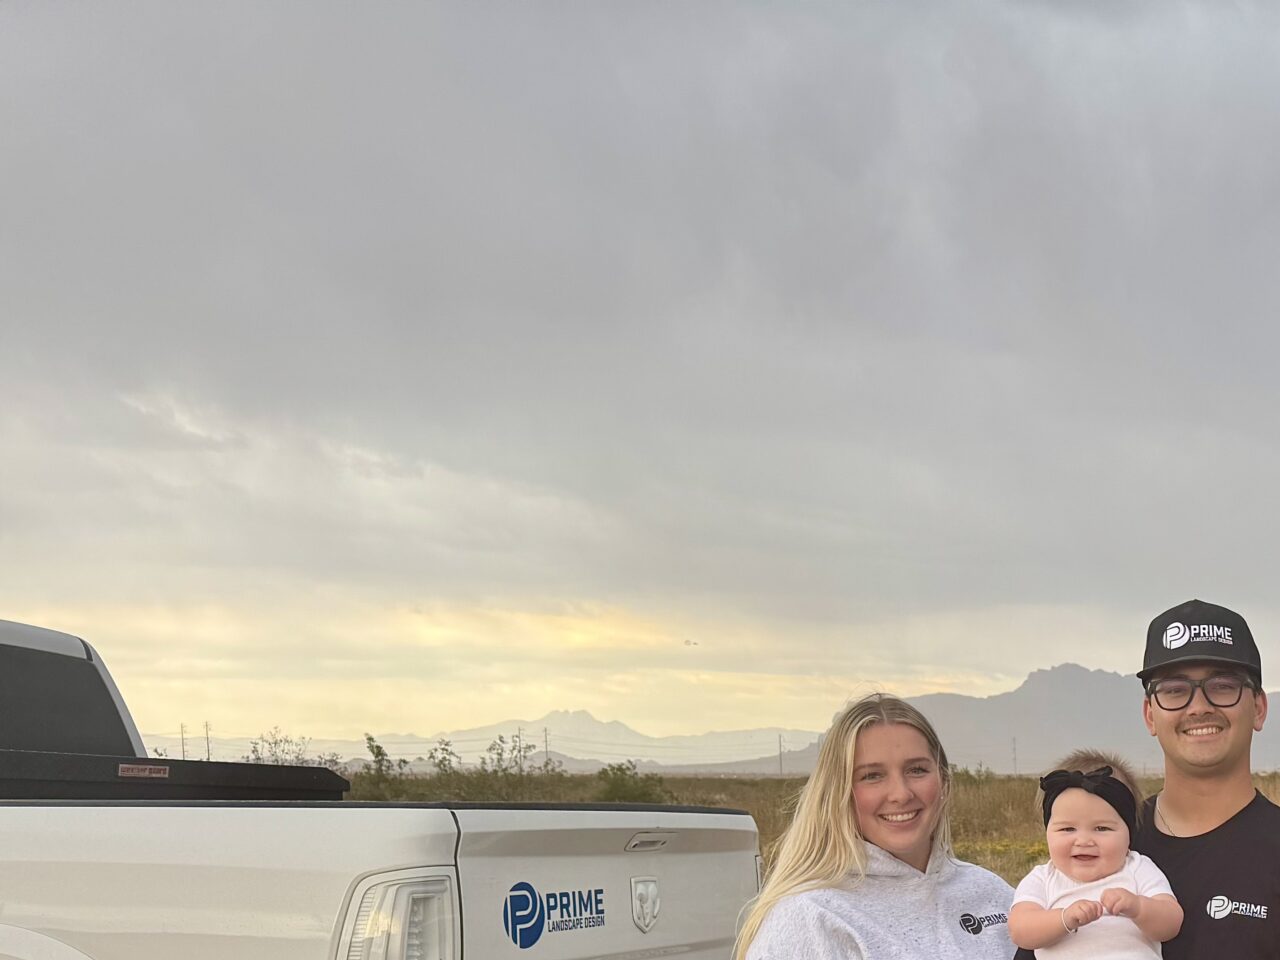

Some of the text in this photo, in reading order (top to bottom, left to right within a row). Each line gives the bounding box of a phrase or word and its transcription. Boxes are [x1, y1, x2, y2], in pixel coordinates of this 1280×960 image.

[1190, 624, 1233, 640] PRIME
[545, 888, 605, 920] PRIME
[1232, 901, 1268, 915] PRIME
[548, 915, 605, 933] LANDSCAPE DESIGN
[979, 913, 1007, 926] PRIME
